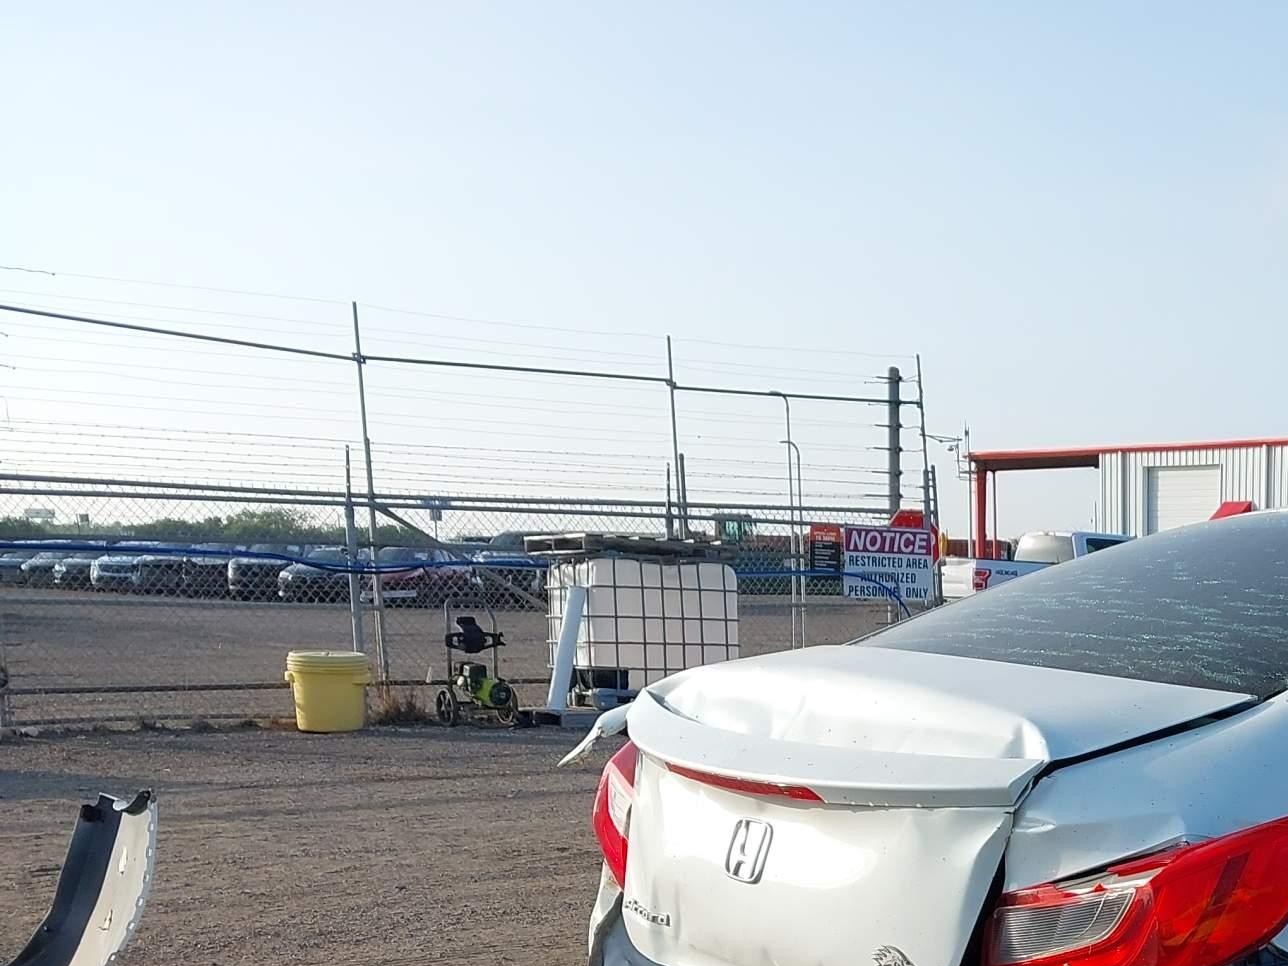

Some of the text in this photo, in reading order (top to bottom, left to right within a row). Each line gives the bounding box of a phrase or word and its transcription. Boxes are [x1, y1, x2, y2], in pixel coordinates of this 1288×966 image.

[849, 530, 928, 554] NOTICE
[848, 555, 903, 569] RESTRICTED
[905, 556, 929, 570] AREA
[848, 584, 929, 599] PERSONNE ONLY
